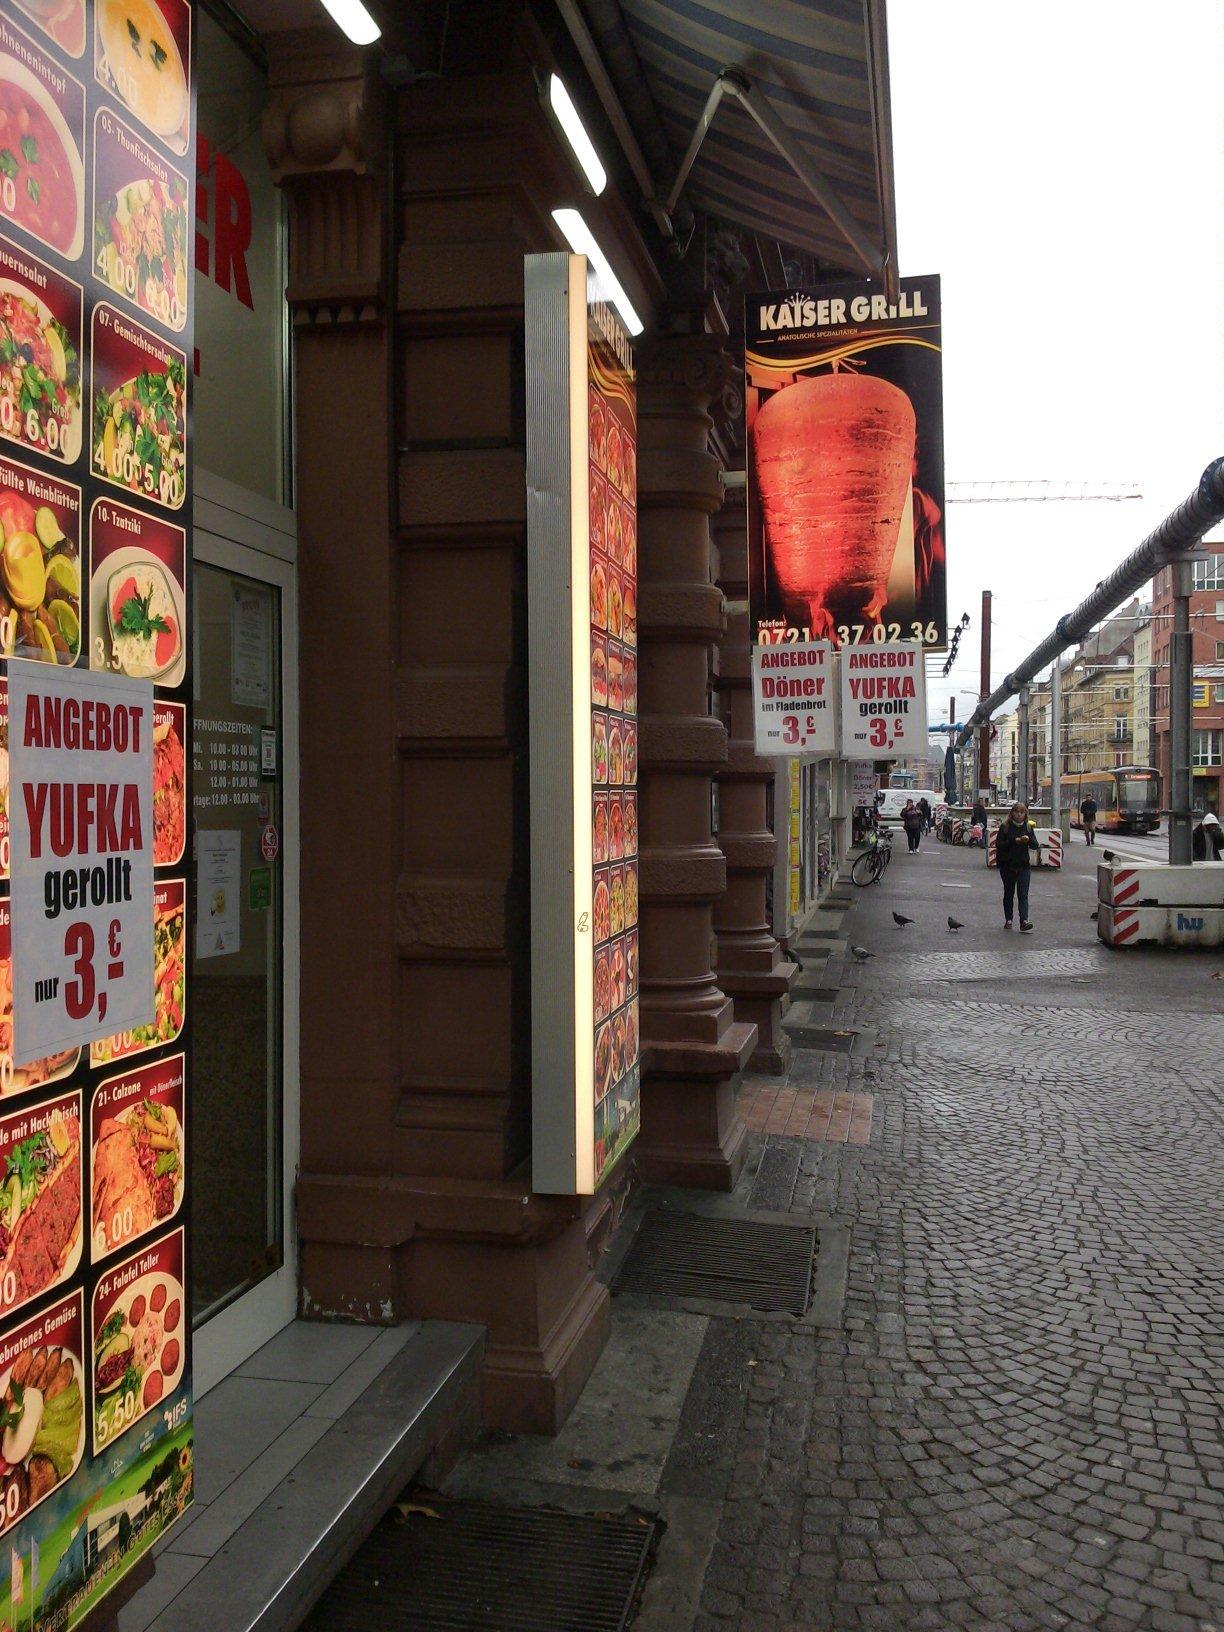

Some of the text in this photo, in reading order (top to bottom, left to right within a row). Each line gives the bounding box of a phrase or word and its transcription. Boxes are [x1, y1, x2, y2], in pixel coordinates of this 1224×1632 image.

[116, 127, 169, 182] Thunfischsalat
[760, 296, 847, 331] KAISER
[26, 477, 79, 512] Weinblätter
[112, 510, 142, 535] Tzatziki
[757, 621, 939, 646] 0721 37 02 36
[760, 650, 826, 669] ANGEBOT
[849, 651, 917, 669] ANGEBOT
[761, 676, 825, 699] Döner
[848, 676, 917, 700] YUFKA
[761, 699, 827, 713] im Fladenbrot
[858, 699, 910, 717] gerollt
[23, 693, 144, 754] ANGEBOT
[192, 718, 253, 735] FFNUNGSZEITEN:
[767, 729, 780, 738] nur
[854, 732, 868, 741] nur
[22, 782, 144, 859] YUFKA
[44, 856, 133, 920] gerollt
[34, 976, 60, 1003] nur
[112, 1081, 142, 1100] Calzone
[11, 1121, 28, 1141] mit
[30, 1100, 79, 1134] Hackfleisch
[95, 1206, 133, 1247] 6.00
[113, 1268, 139, 1289] Falafel
[140, 1252, 160, 1275] Teller
[44, 1304, 77, 1331] Gemüse
[97, 1390, 136, 1442] 5.50
[172, 1398, 187, 1423] IFS
